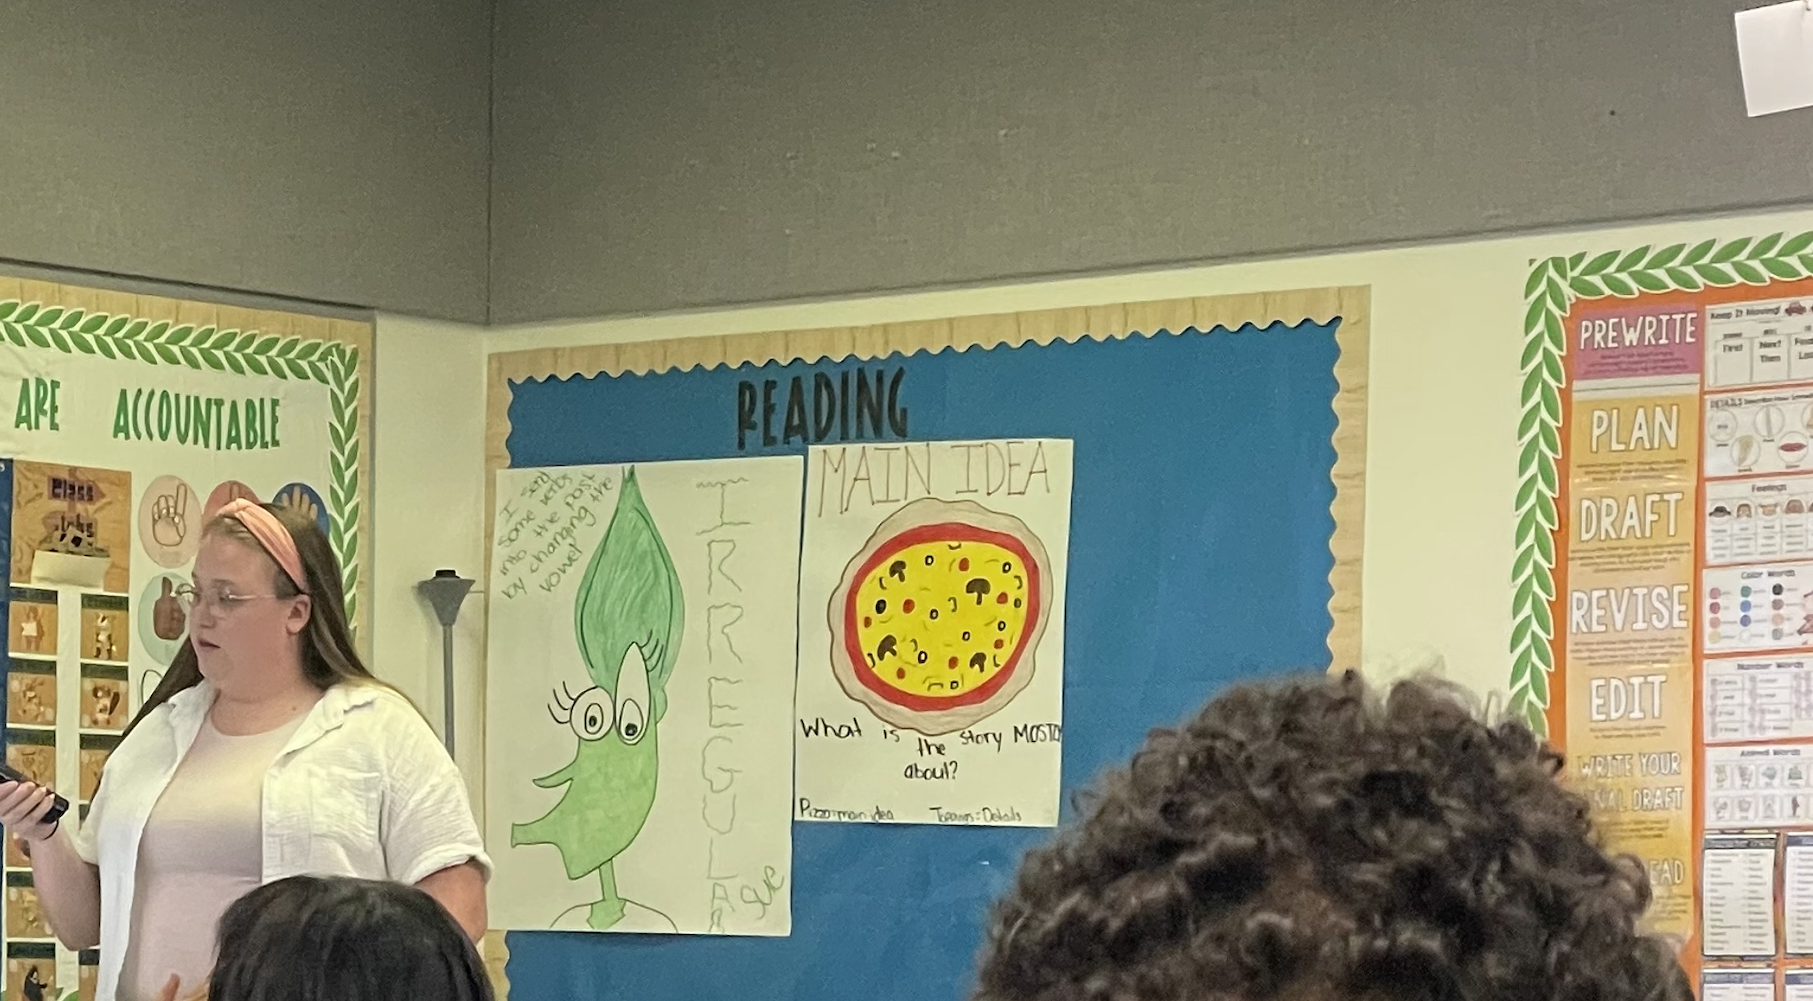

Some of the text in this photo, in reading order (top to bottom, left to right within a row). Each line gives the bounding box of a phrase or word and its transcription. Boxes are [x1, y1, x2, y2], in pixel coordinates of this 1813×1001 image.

[1580, 312, 1698, 349] PREWRITE
[14, 377, 60, 431] ARE
[112, 387, 280, 451] ACCOUNTABLE
[737, 366, 908, 450] READING
[1591, 404, 1679, 454] PLAN
[590, 477, 613, 502] the
[818, 441, 1050, 517] MAIN IDEA
[533, 512, 560, 538] the
[1580, 491, 1684, 542] DRAFT
[1570, 582, 1689, 634] REVISE
[1589, 673, 1667, 723] EDIT
[800, 717, 862, 739] What
[883, 727, 900, 743] is
[918, 738, 946, 757] the
[959, 730, 1002, 753] story
[1639, 752, 1682, 777] YOUR
[1632, 787, 1685, 811] DRAFT
